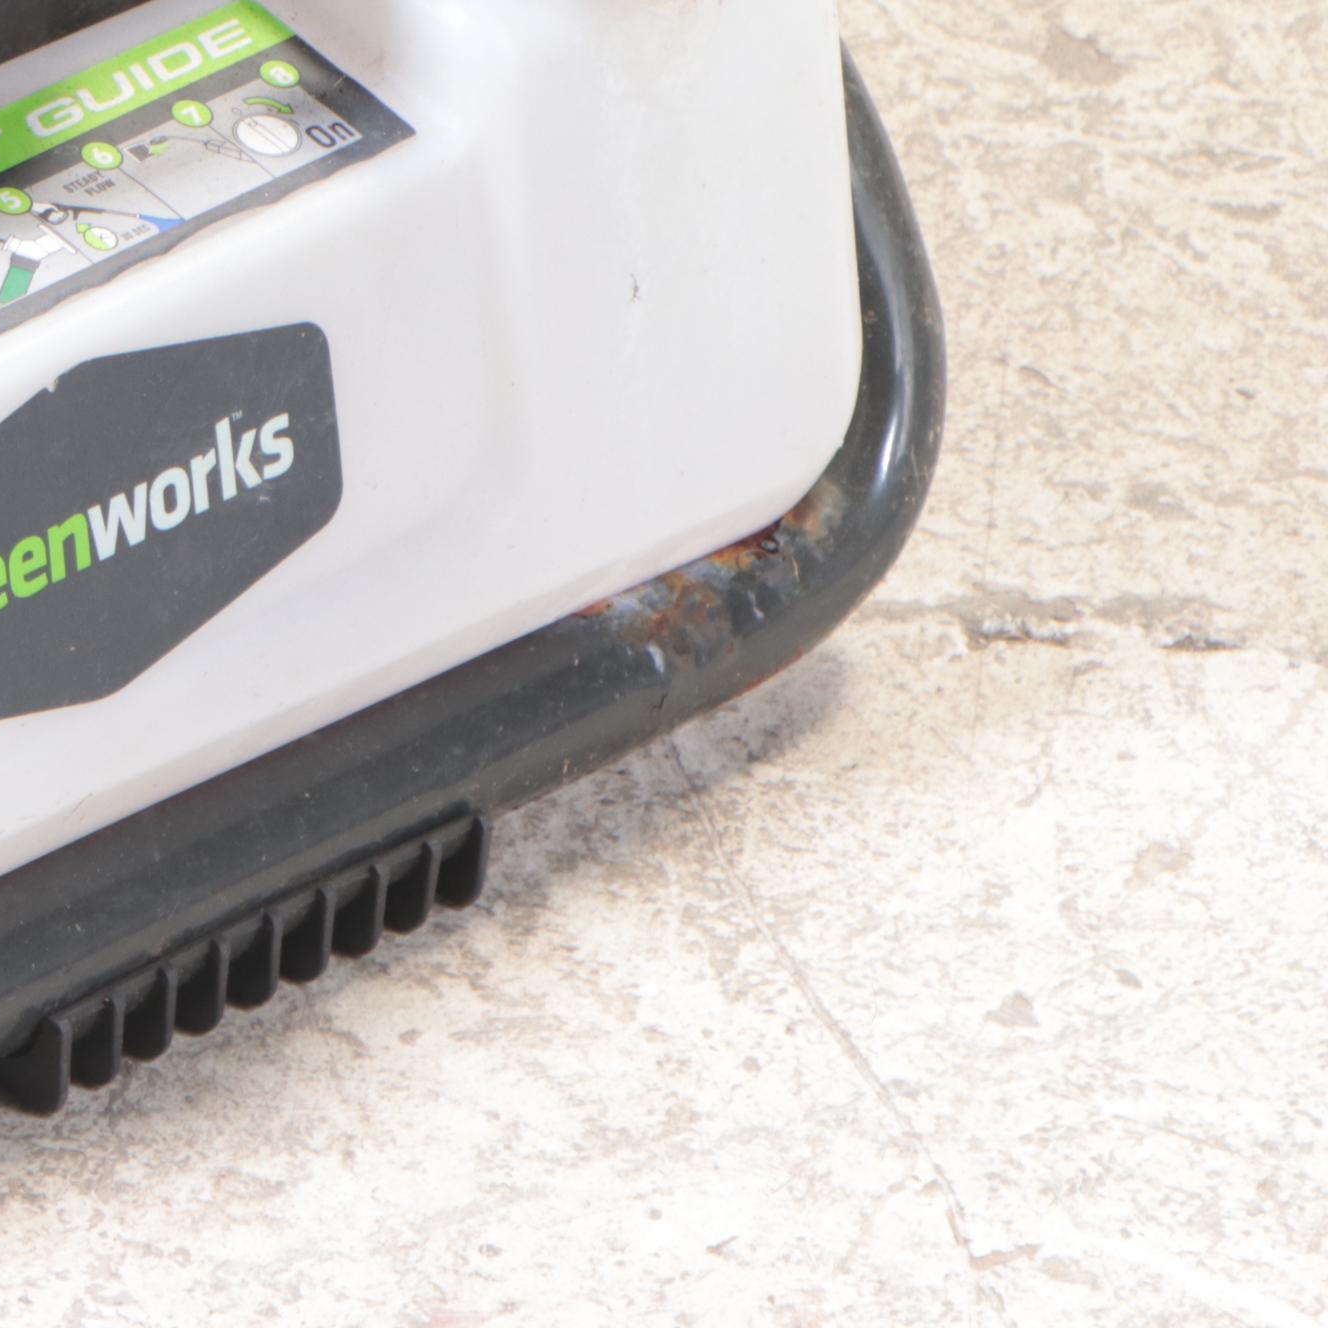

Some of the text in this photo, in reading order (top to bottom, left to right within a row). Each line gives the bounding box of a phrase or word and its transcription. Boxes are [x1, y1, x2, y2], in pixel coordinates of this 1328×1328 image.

[25, 18, 253, 136] GUIDE
[181, 104, 202, 124] 7
[305, 121, 355, 148] On
[92, 146, 112, 167] 6
[0, 190, 21, 210] 5
